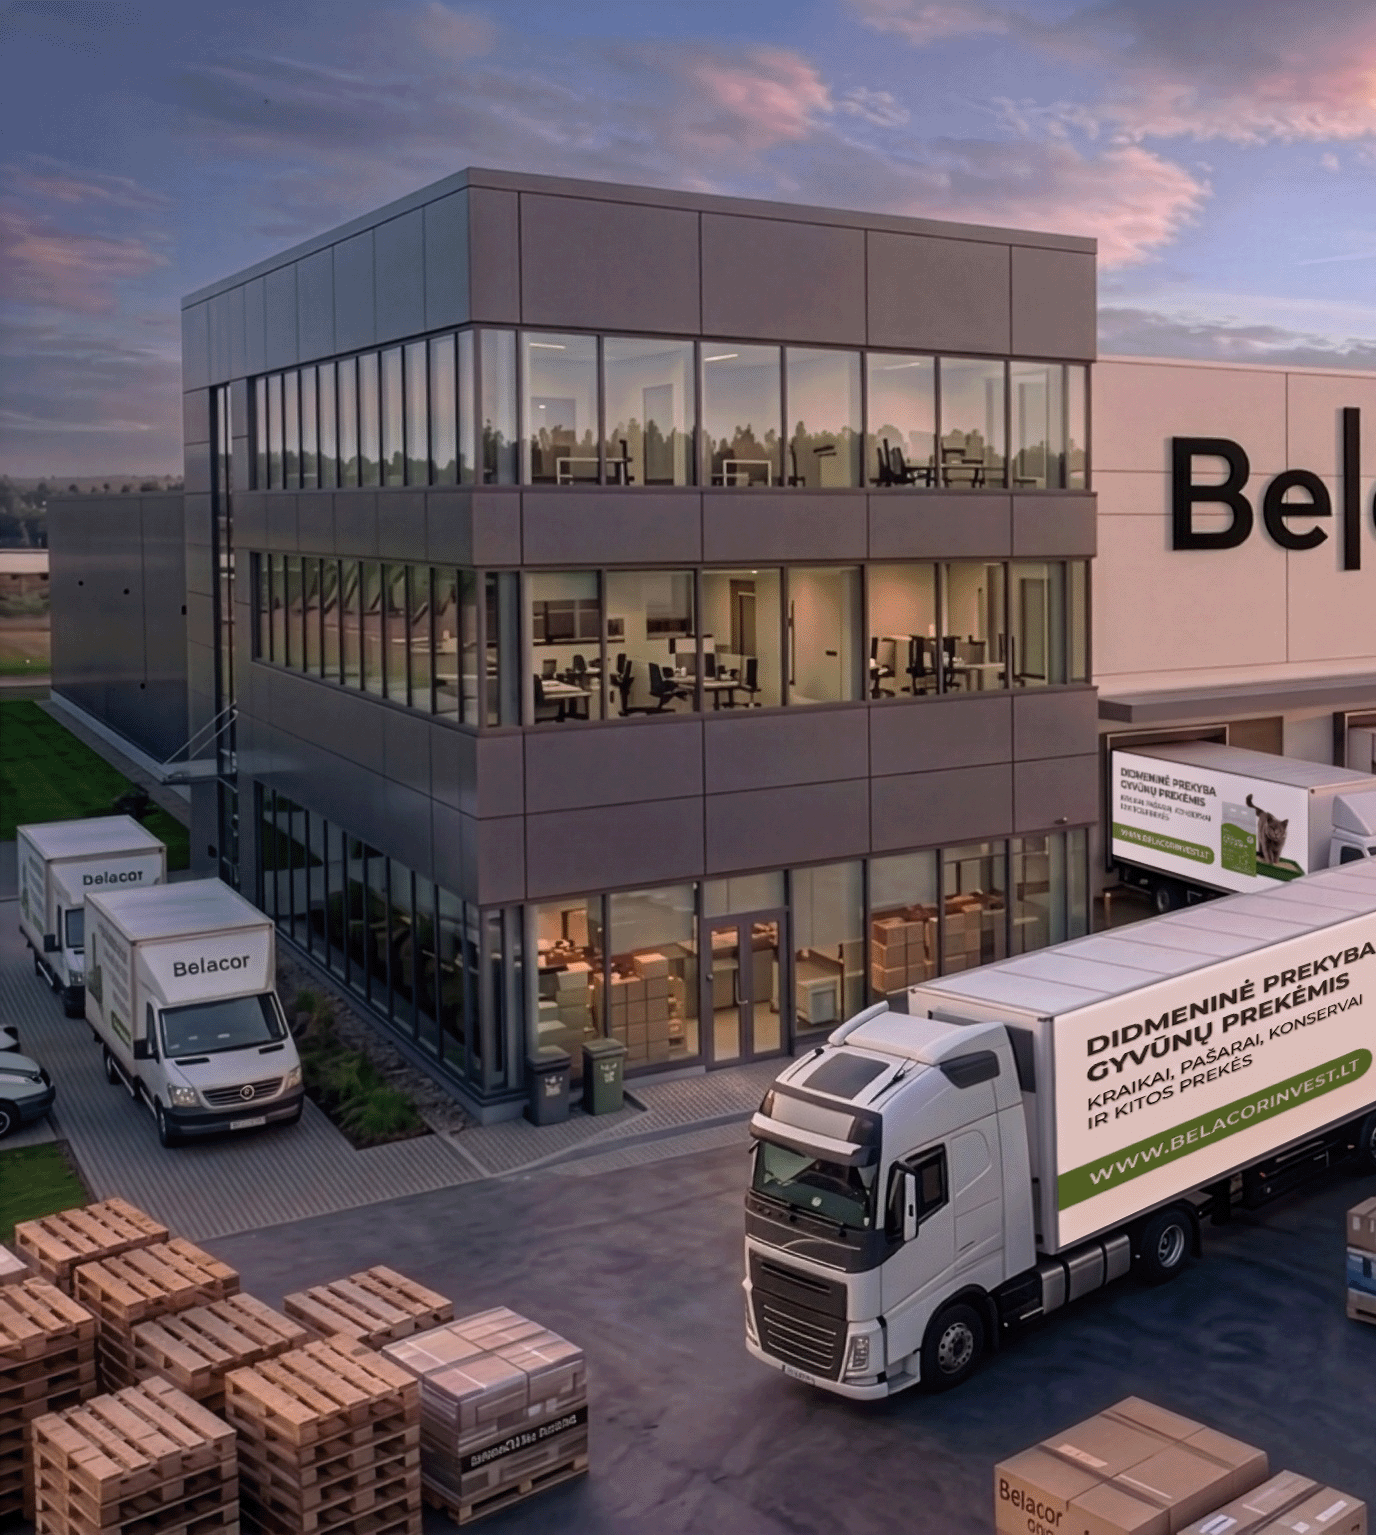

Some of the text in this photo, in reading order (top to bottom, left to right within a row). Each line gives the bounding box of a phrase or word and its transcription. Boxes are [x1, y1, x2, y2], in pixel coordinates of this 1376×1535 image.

[173, 955, 250, 977] Belacor
[1087, 941, 1376, 1056] DIDMENINĖ PREKYBA
[1087, 1021, 1213, 1082] GYVŪNŲ
[1222, 972, 1350, 1033] PREKĖMIS
[1087, 1067, 1174, 1111] KRAIKAI,
[1181, 1033, 1264, 1075] PAŠARAI,
[1269, 994, 1363, 1040] KONSERVAI
[1088, 1054, 1253, 1130] IR KITOS PREKĖS
[1089, 1059, 1360, 1185] WWW.BELACORINVEST.LT
[1000, 1478, 1063, 1527] Belacor
